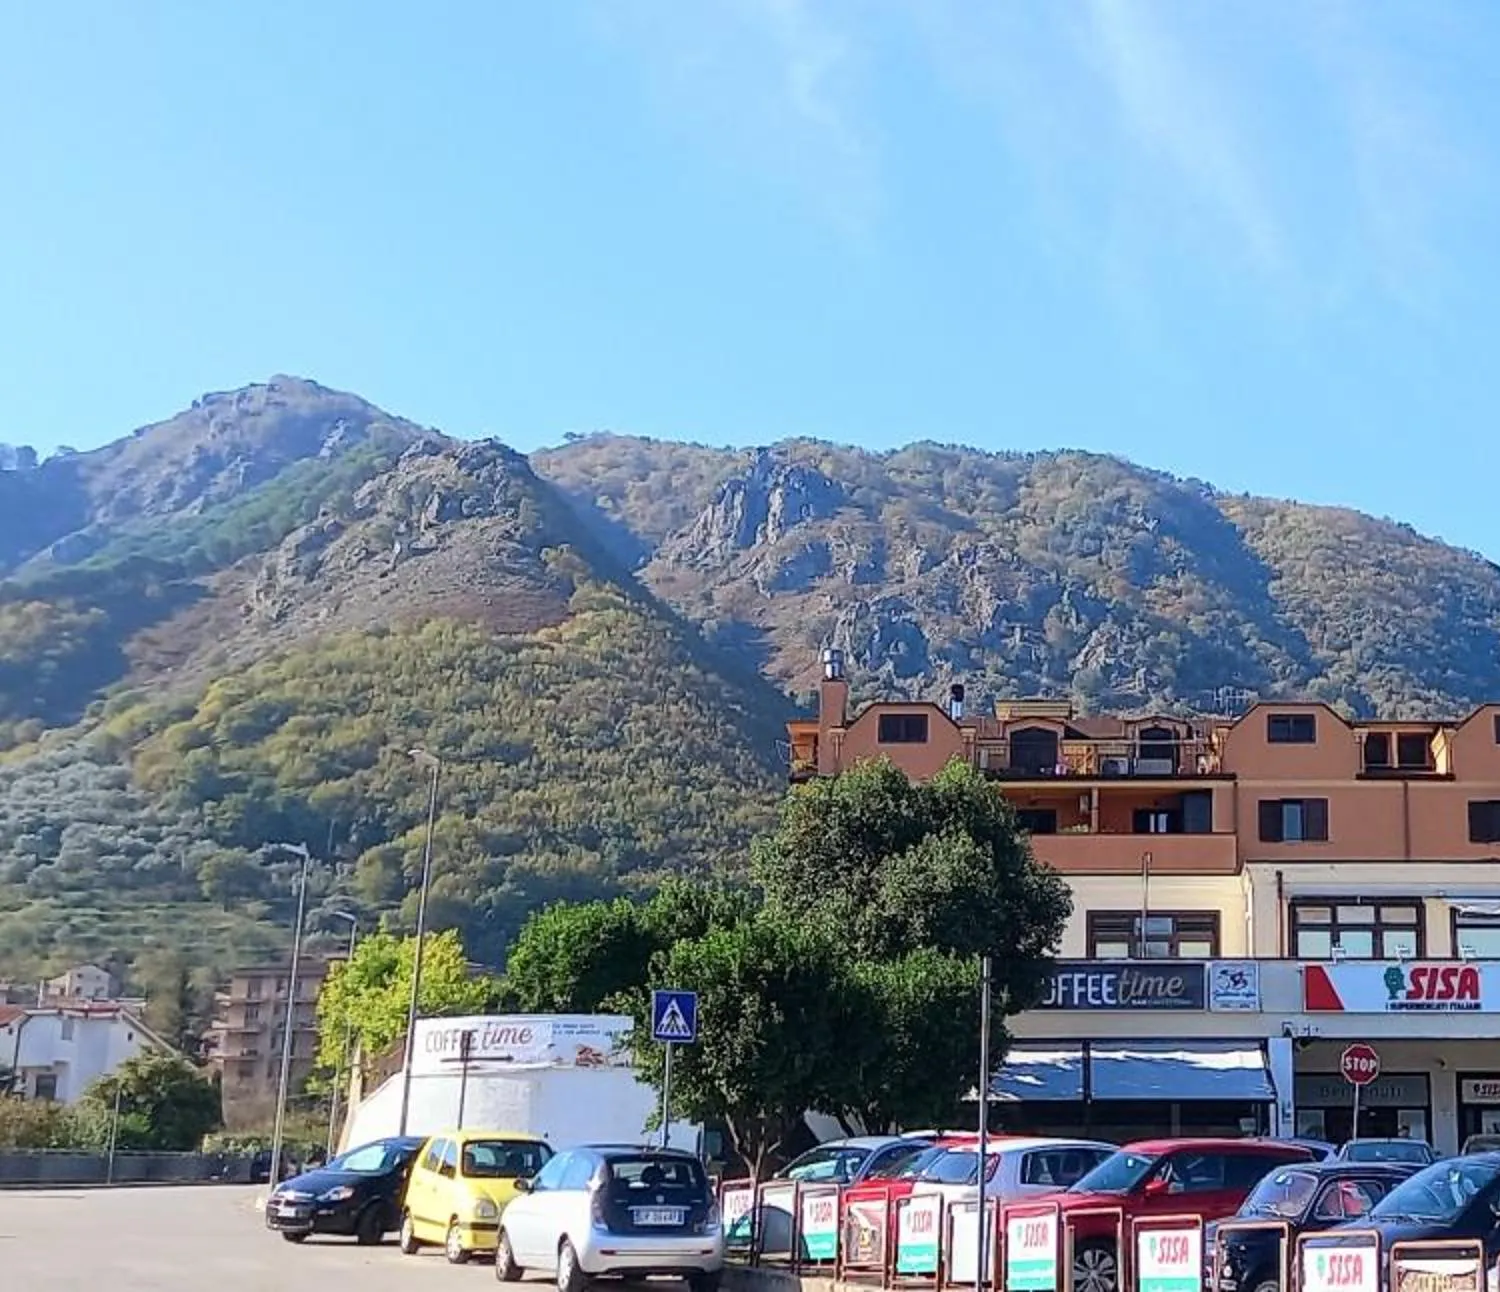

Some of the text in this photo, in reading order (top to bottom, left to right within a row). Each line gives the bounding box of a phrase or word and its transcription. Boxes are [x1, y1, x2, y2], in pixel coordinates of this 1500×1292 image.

[1041, 973, 1117, 1006] OFFEE
[1117, 968, 1185, 1006] time
[1406, 967, 1480, 1001] SISA
[481, 1021, 533, 1052] time
[1344, 1056, 1377, 1073] STOP
[1023, 1222, 1049, 1249] SISA
[1157, 1235, 1190, 1265] SISA
[1327, 1253, 1364, 1286] SISA
